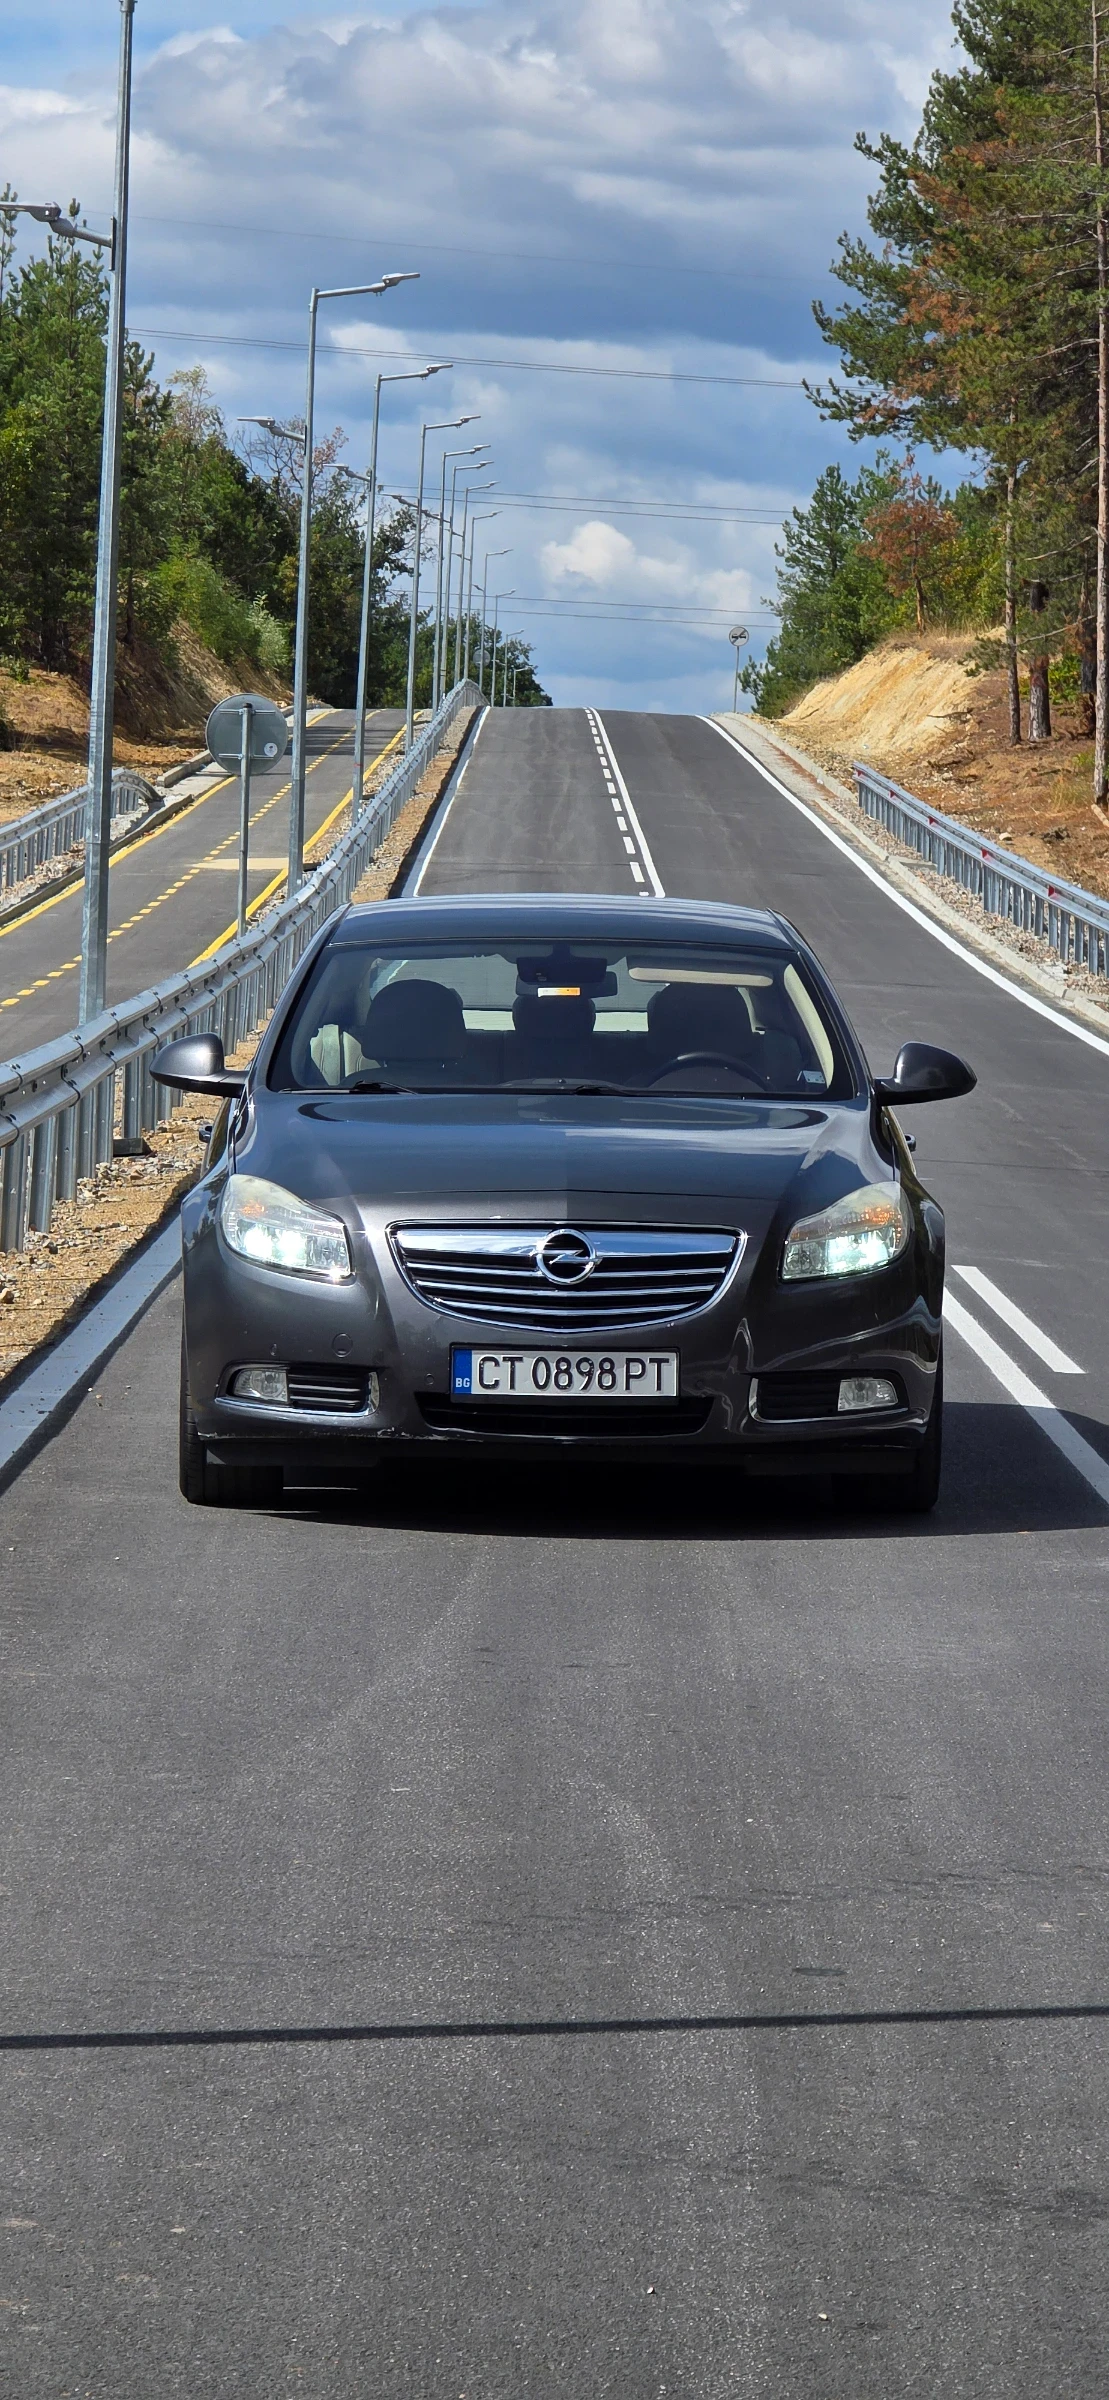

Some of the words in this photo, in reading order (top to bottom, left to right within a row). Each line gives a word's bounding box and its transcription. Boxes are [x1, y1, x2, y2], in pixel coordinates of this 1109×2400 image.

[455, 1378, 470, 1388] BG
[478, 1355, 523, 1390] CT
[531, 1356, 617, 1391] 0898
[624, 1357, 669, 1391] PT
